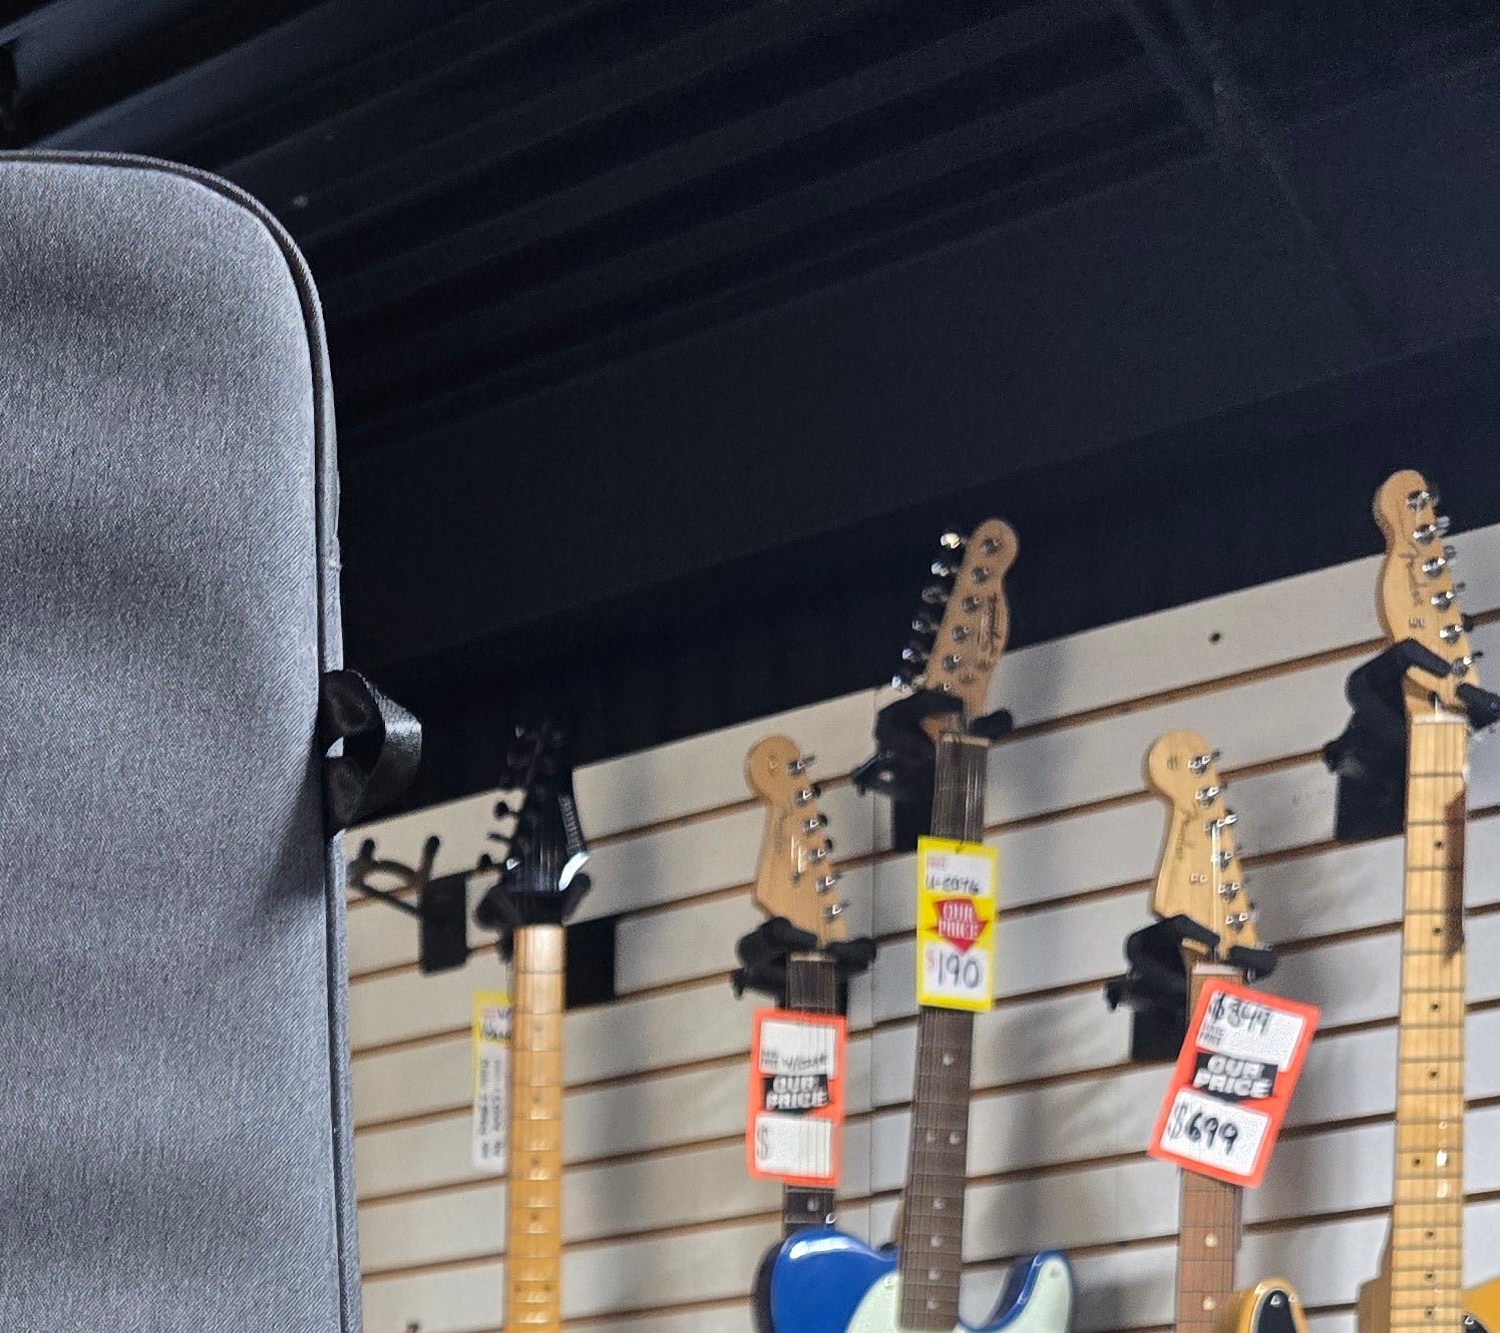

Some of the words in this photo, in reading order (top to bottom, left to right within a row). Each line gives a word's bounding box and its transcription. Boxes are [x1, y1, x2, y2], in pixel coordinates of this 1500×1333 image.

[943, 902, 974, 922] OUR
[938, 919, 979, 941] PRICE
[1208, 1054, 1265, 1079] OUR
[772, 1075, 821, 1095] OUR
[1193, 1068, 1273, 1099] PRICE
[765, 1090, 830, 1111] PRICE
[1168, 1102, 1239, 1156] $699
